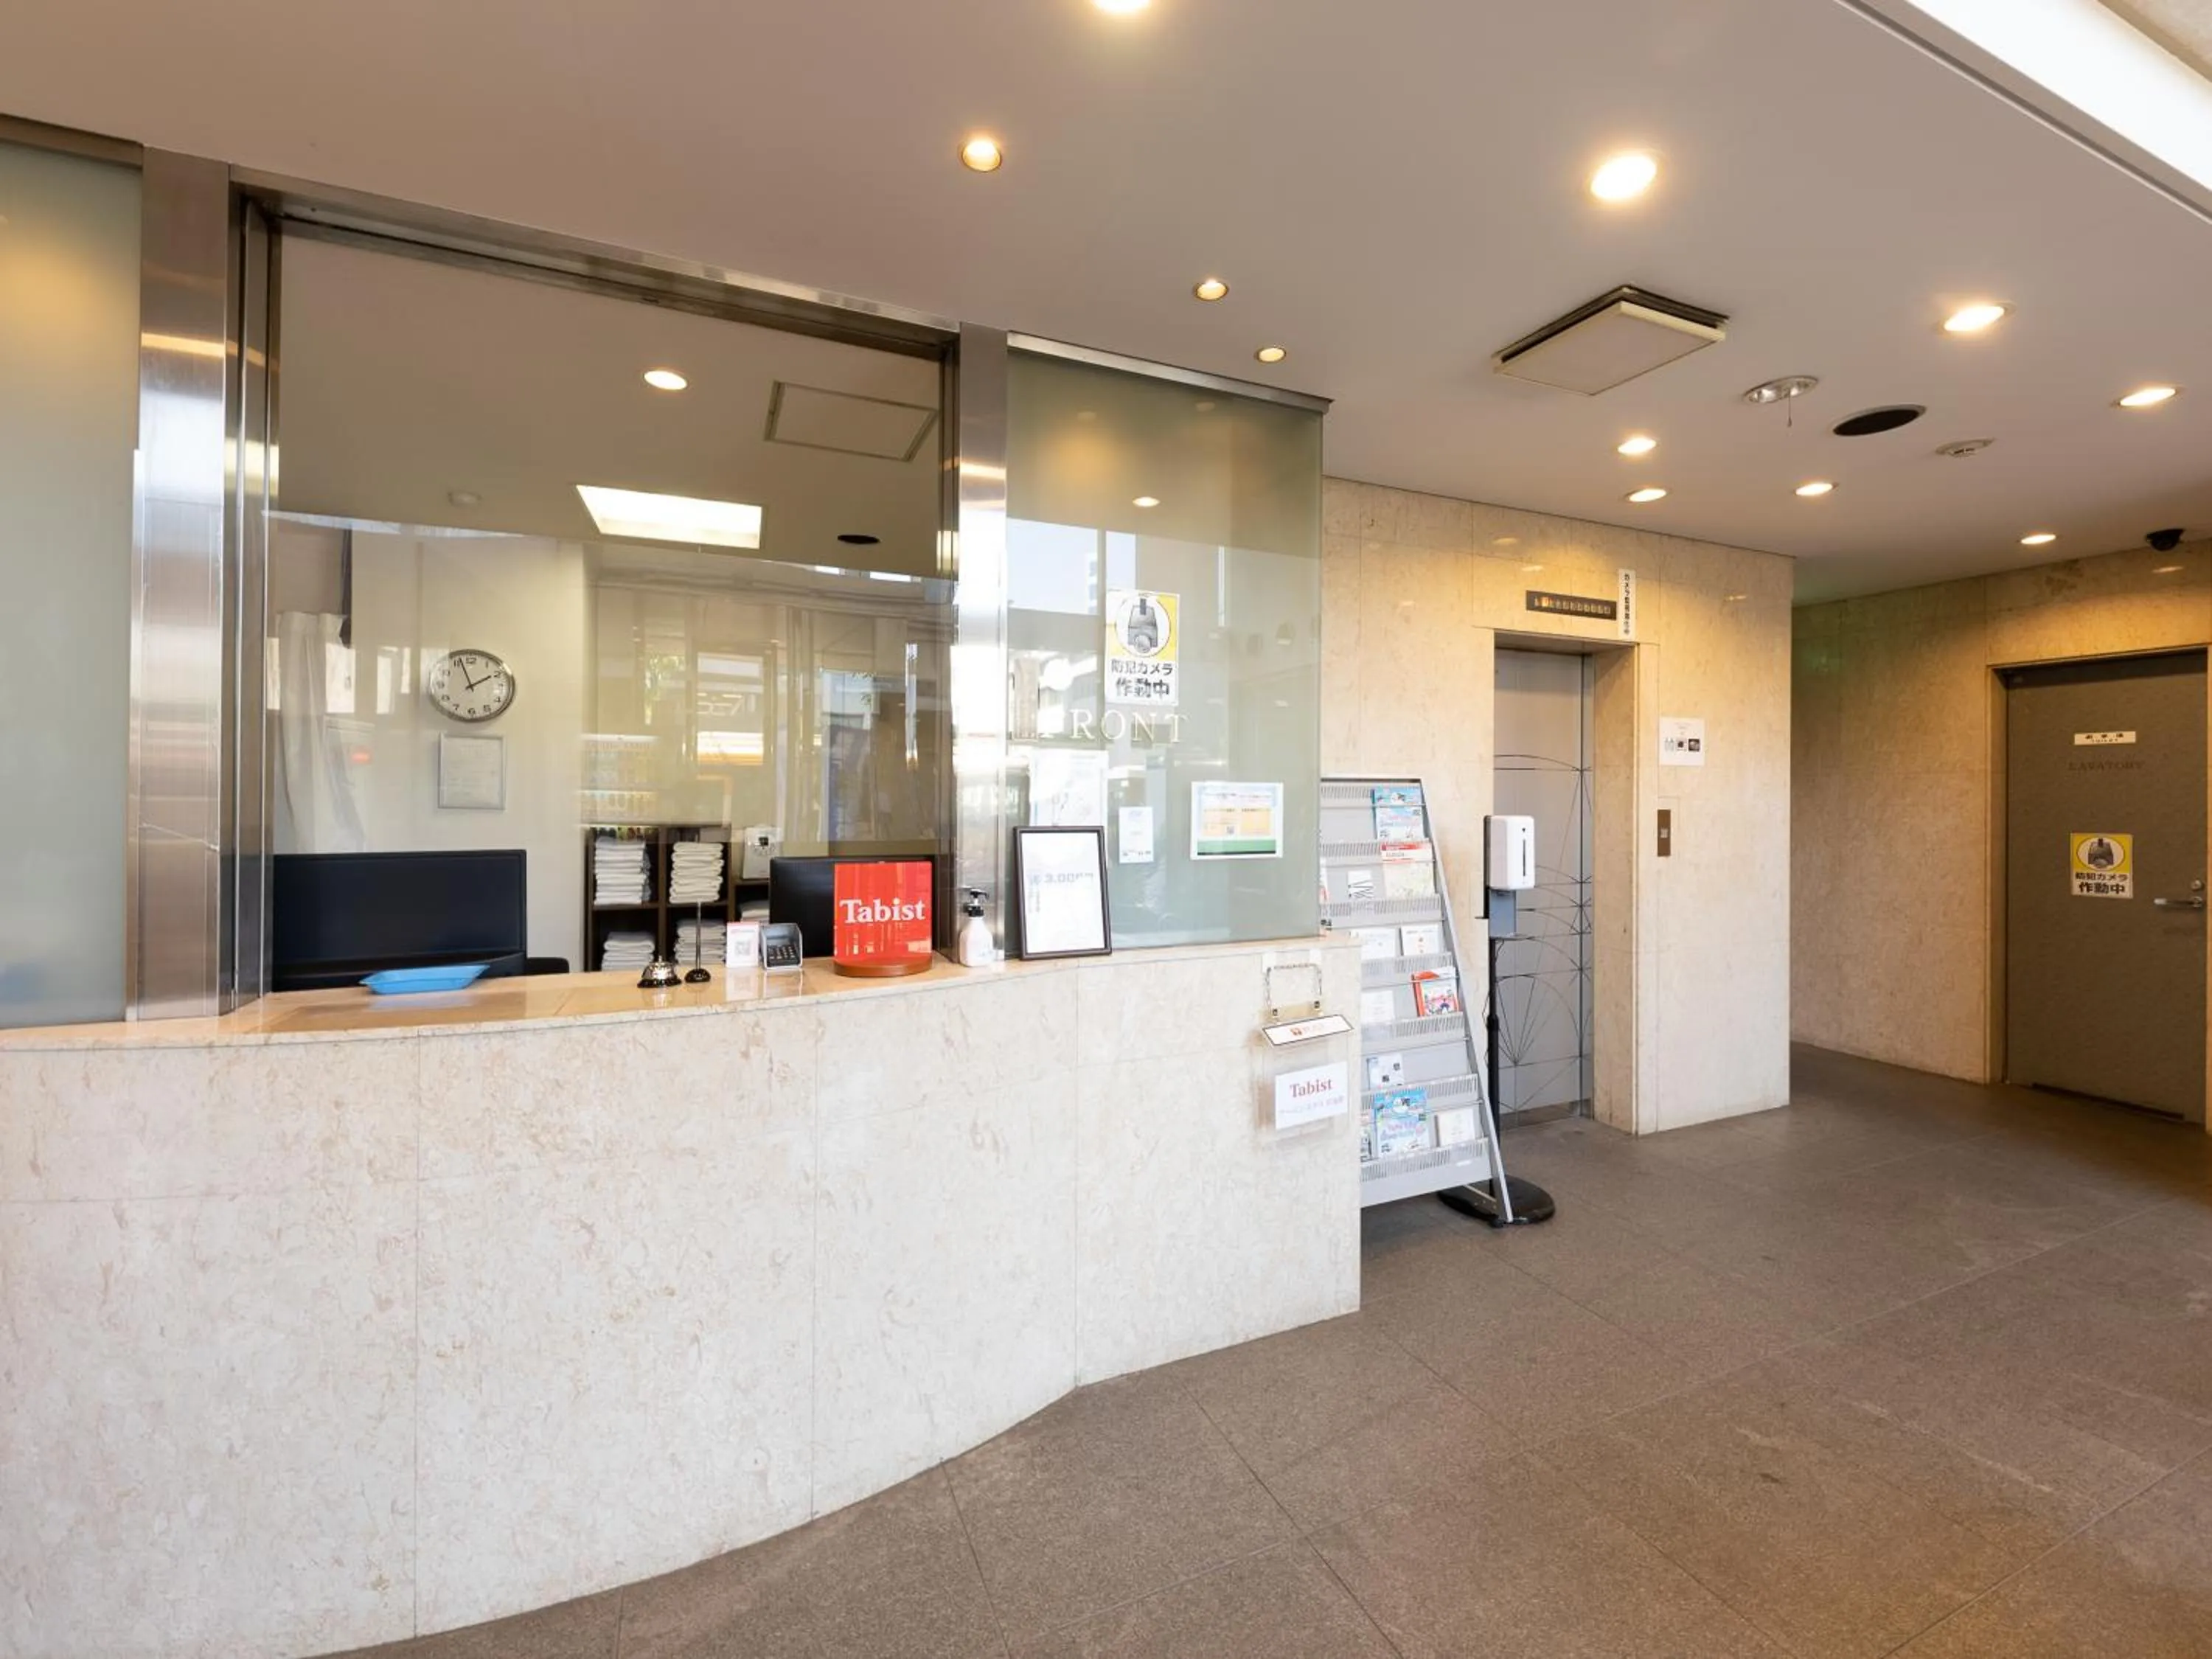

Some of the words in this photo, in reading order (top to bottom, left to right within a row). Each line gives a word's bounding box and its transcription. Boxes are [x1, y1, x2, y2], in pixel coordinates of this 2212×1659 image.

[1111, 659, 1173, 675] 防犯カメラ
[1116, 678, 1169, 699] 作動中
[1040, 709, 1189, 742] RONT
[2079, 882, 2125, 894] 作動中
[839, 897, 926, 923] Tabist
[1289, 1078, 1332, 1098] Tabist
